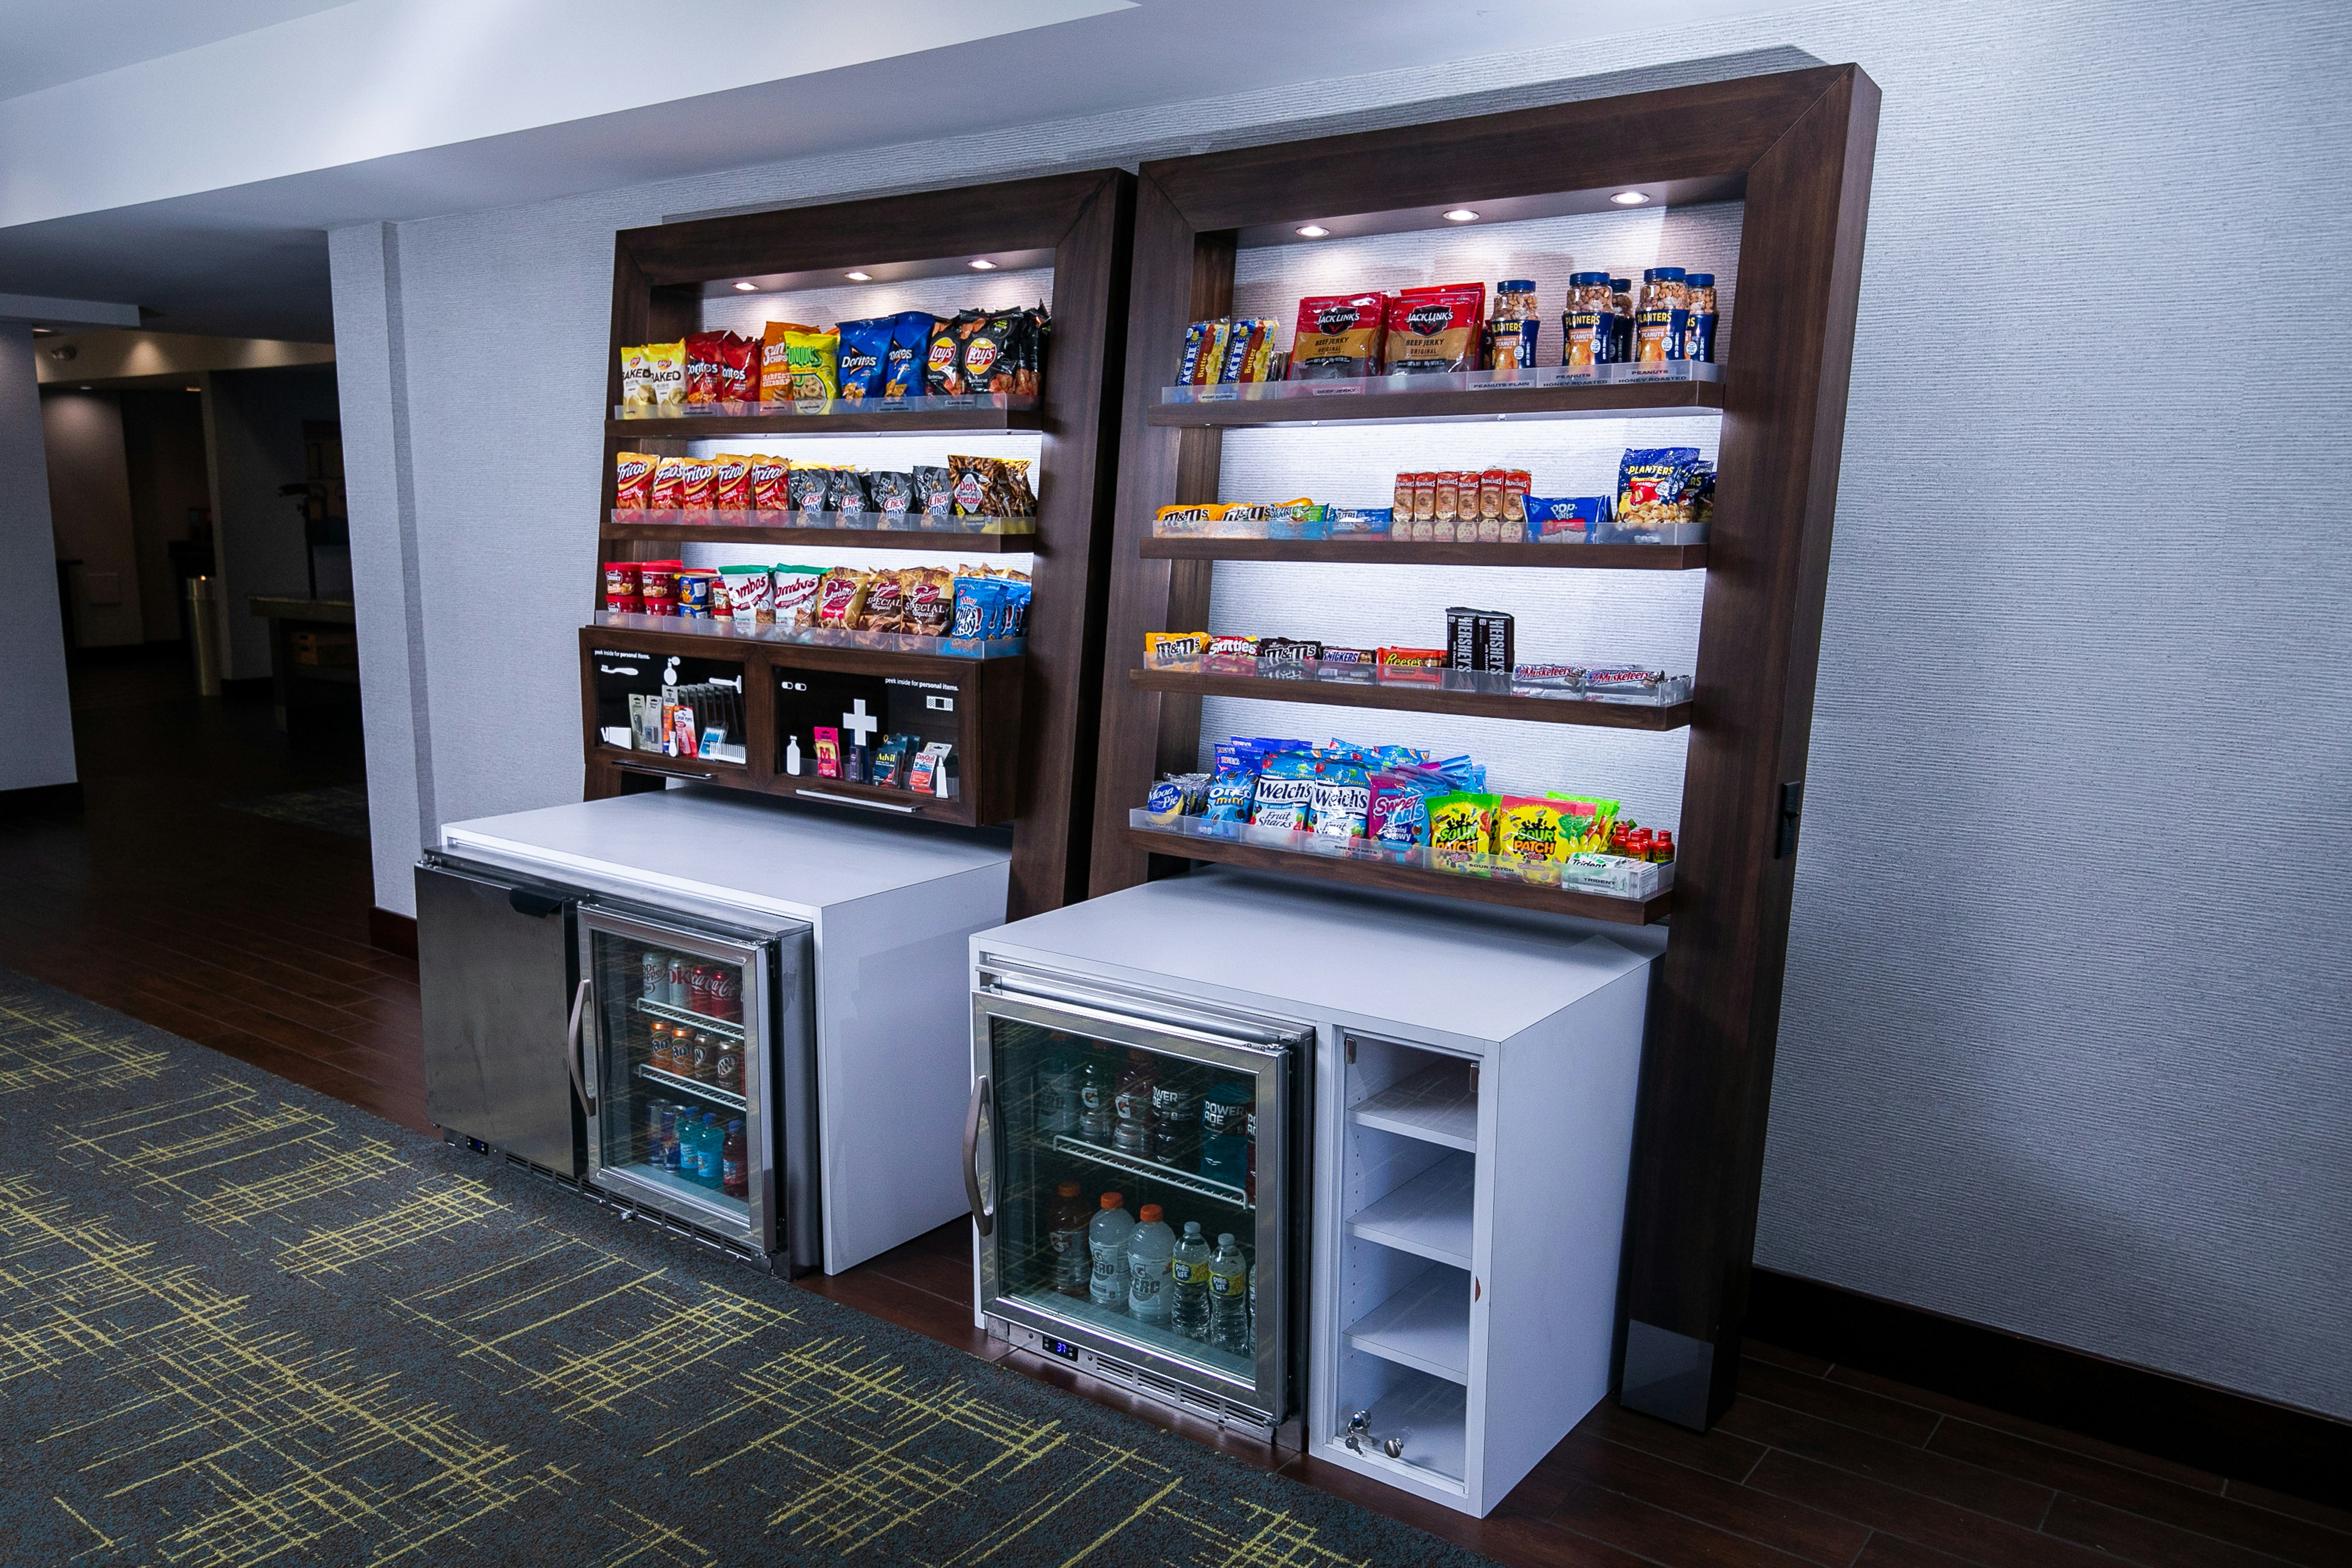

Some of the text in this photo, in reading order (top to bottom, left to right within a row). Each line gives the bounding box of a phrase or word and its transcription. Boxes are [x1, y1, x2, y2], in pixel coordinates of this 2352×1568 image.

[1316, 315, 1335, 325] JACK
[1406, 313, 1427, 323] JACK
[1565, 315, 1601, 326] PLANTERS
[1637, 312, 1672, 323] PLANTERS
[1492, 322, 1523, 333] PLANTERS
[1328, 337, 1349, 345] JERKY
[1422, 338, 1445, 346] JERKY
[770, 354, 788, 364] CHIPS
[929, 345, 954, 364] Lay's
[966, 346, 994, 366] Lay's
[1227, 342, 1245, 379] ACT II
[841, 356, 877, 368] Doritos
[1197, 352, 1208, 378] Butter
[1244, 348, 1257, 374] Butter
[762, 372, 791, 382] HARVEST
[1181, 359, 1195, 384] ACT
[617, 462, 647, 483] Fritos
[685, 465, 713, 484] Fritos
[1627, 466, 1674, 475] PLANTERS
[960, 480, 977, 491] Dot's
[1504, 479, 1527, 488] MUNCHIES
[802, 493, 821, 505] Chex
[885, 496, 905, 510] Chex
[929, 493, 949, 506] Chex
[955, 494, 982, 505] Pretzels
[866, 596, 901, 607] SPECIAL
[961, 596, 978, 606] Mini
[906, 602, 945, 613] SPECIAL
[956, 606, 976, 620] Chips
[912, 610, 935, 618] Request
[1457, 617, 1473, 673] HERSHEY'S
[1489, 620, 1505, 676] HERSHEY'S
[1323, 650, 1359, 663] SNICKERS
[1385, 653, 1422, 667] Reese's
[1523, 667, 1572, 679] Musketeers
[1597, 671, 1649, 685] Musketeers
[919, 681, 942, 689] personal
[820, 746, 832, 759] M
[877, 752, 896, 762] Advil
[1148, 786, 1174, 803] Moon
[1209, 787, 1252, 799] OREO
[1259, 782, 1312, 800] Welch's
[1162, 794, 1178, 808] Pie
[1215, 796, 1244, 807] mini
[1265, 811, 1291, 820] Fruit
[1258, 817, 1293, 828] Snacks
[1440, 826, 1477, 841] SOUR
[1517, 829, 1555, 842] SOUR
[1436, 839, 1477, 853] PATCH
[1514, 841, 1555, 855] PATCH
[1527, 852, 1545, 860] Kids
[1572, 858, 1607, 869] Trident
[646, 964, 657, 973] Dr
[1081, 1087, 1099, 1108] G
[1115, 1096, 1131, 1119] G
[1205, 1101, 1244, 1116] POWER
[1204, 1110, 1224, 1125] ADE
[1093, 1249, 1103, 1262] G
[1133, 1263, 1147, 1279] G
[1056, 1342, 1068, 1353] 37
